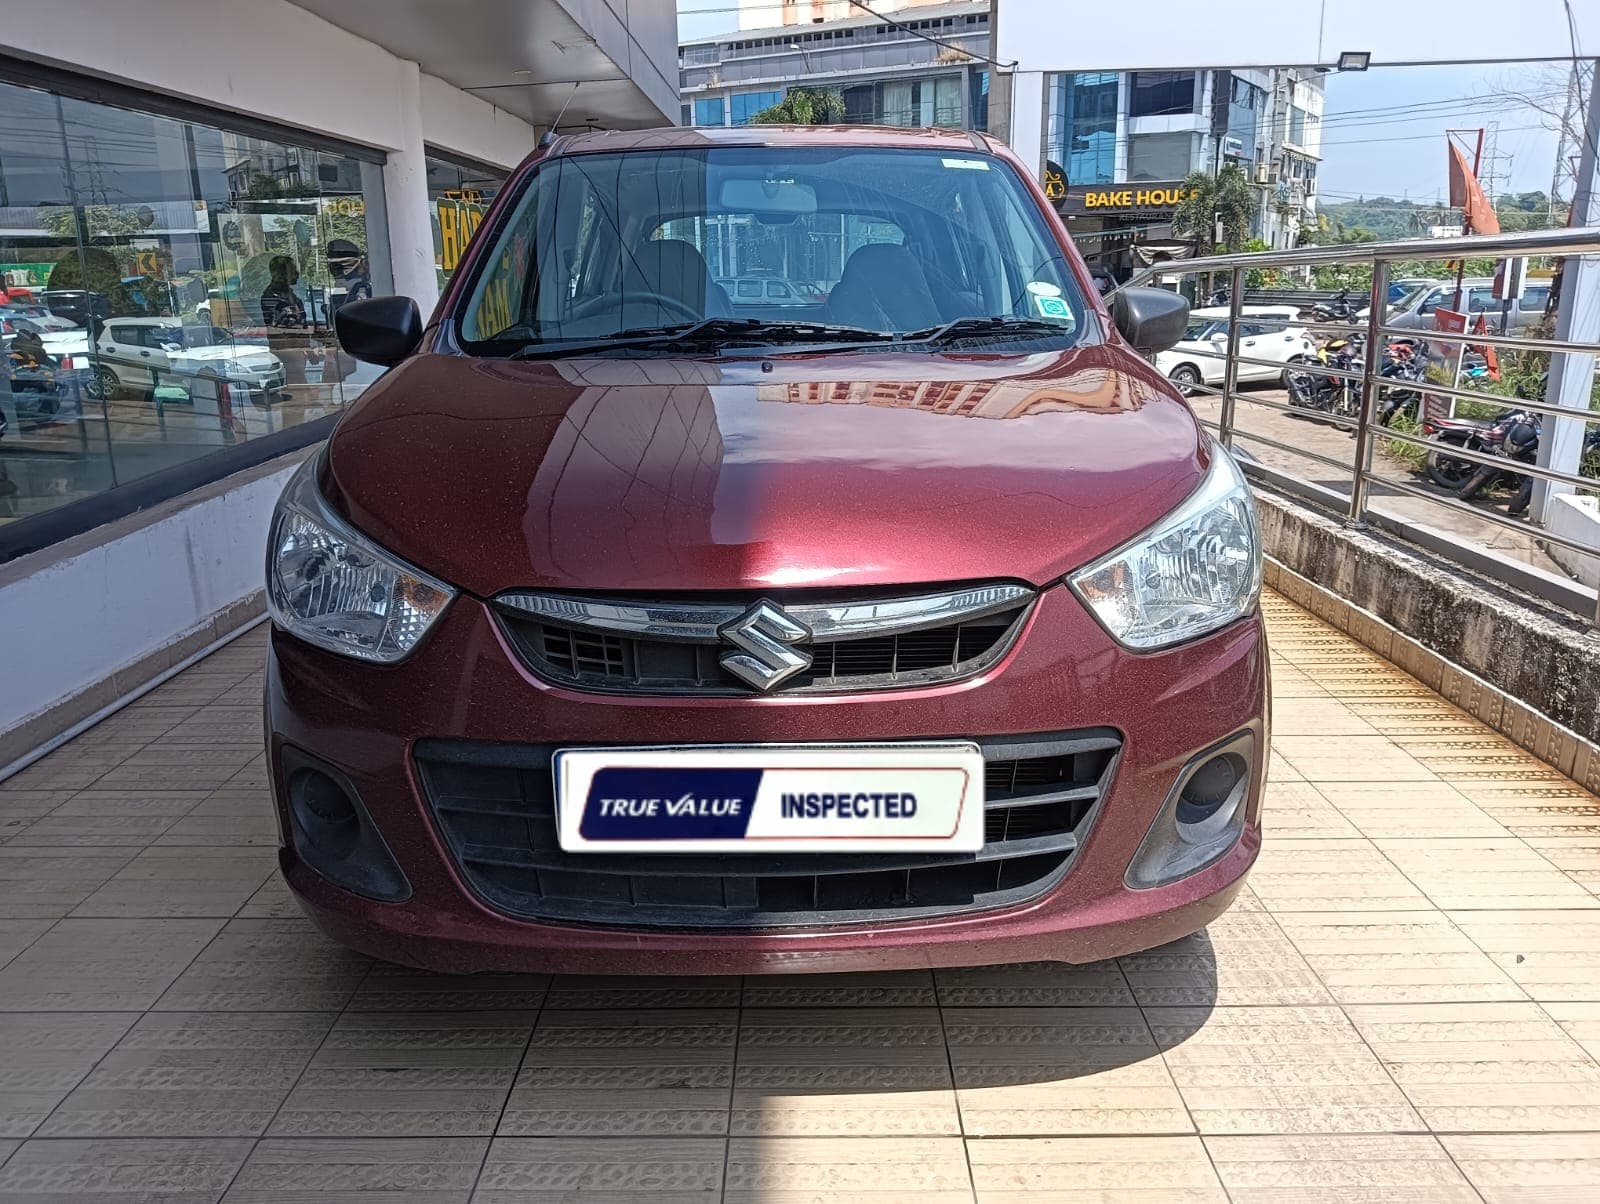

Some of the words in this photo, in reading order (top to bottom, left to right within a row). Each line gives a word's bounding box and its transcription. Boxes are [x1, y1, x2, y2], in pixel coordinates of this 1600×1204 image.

[1085, 192, 1132, 208] BAKE
[1136, 188, 1200, 206] HOU
[600, 799, 659, 817] TRUE
[665, 792, 742, 817] VALUE
[780, 793, 918, 818] INSPECTED
